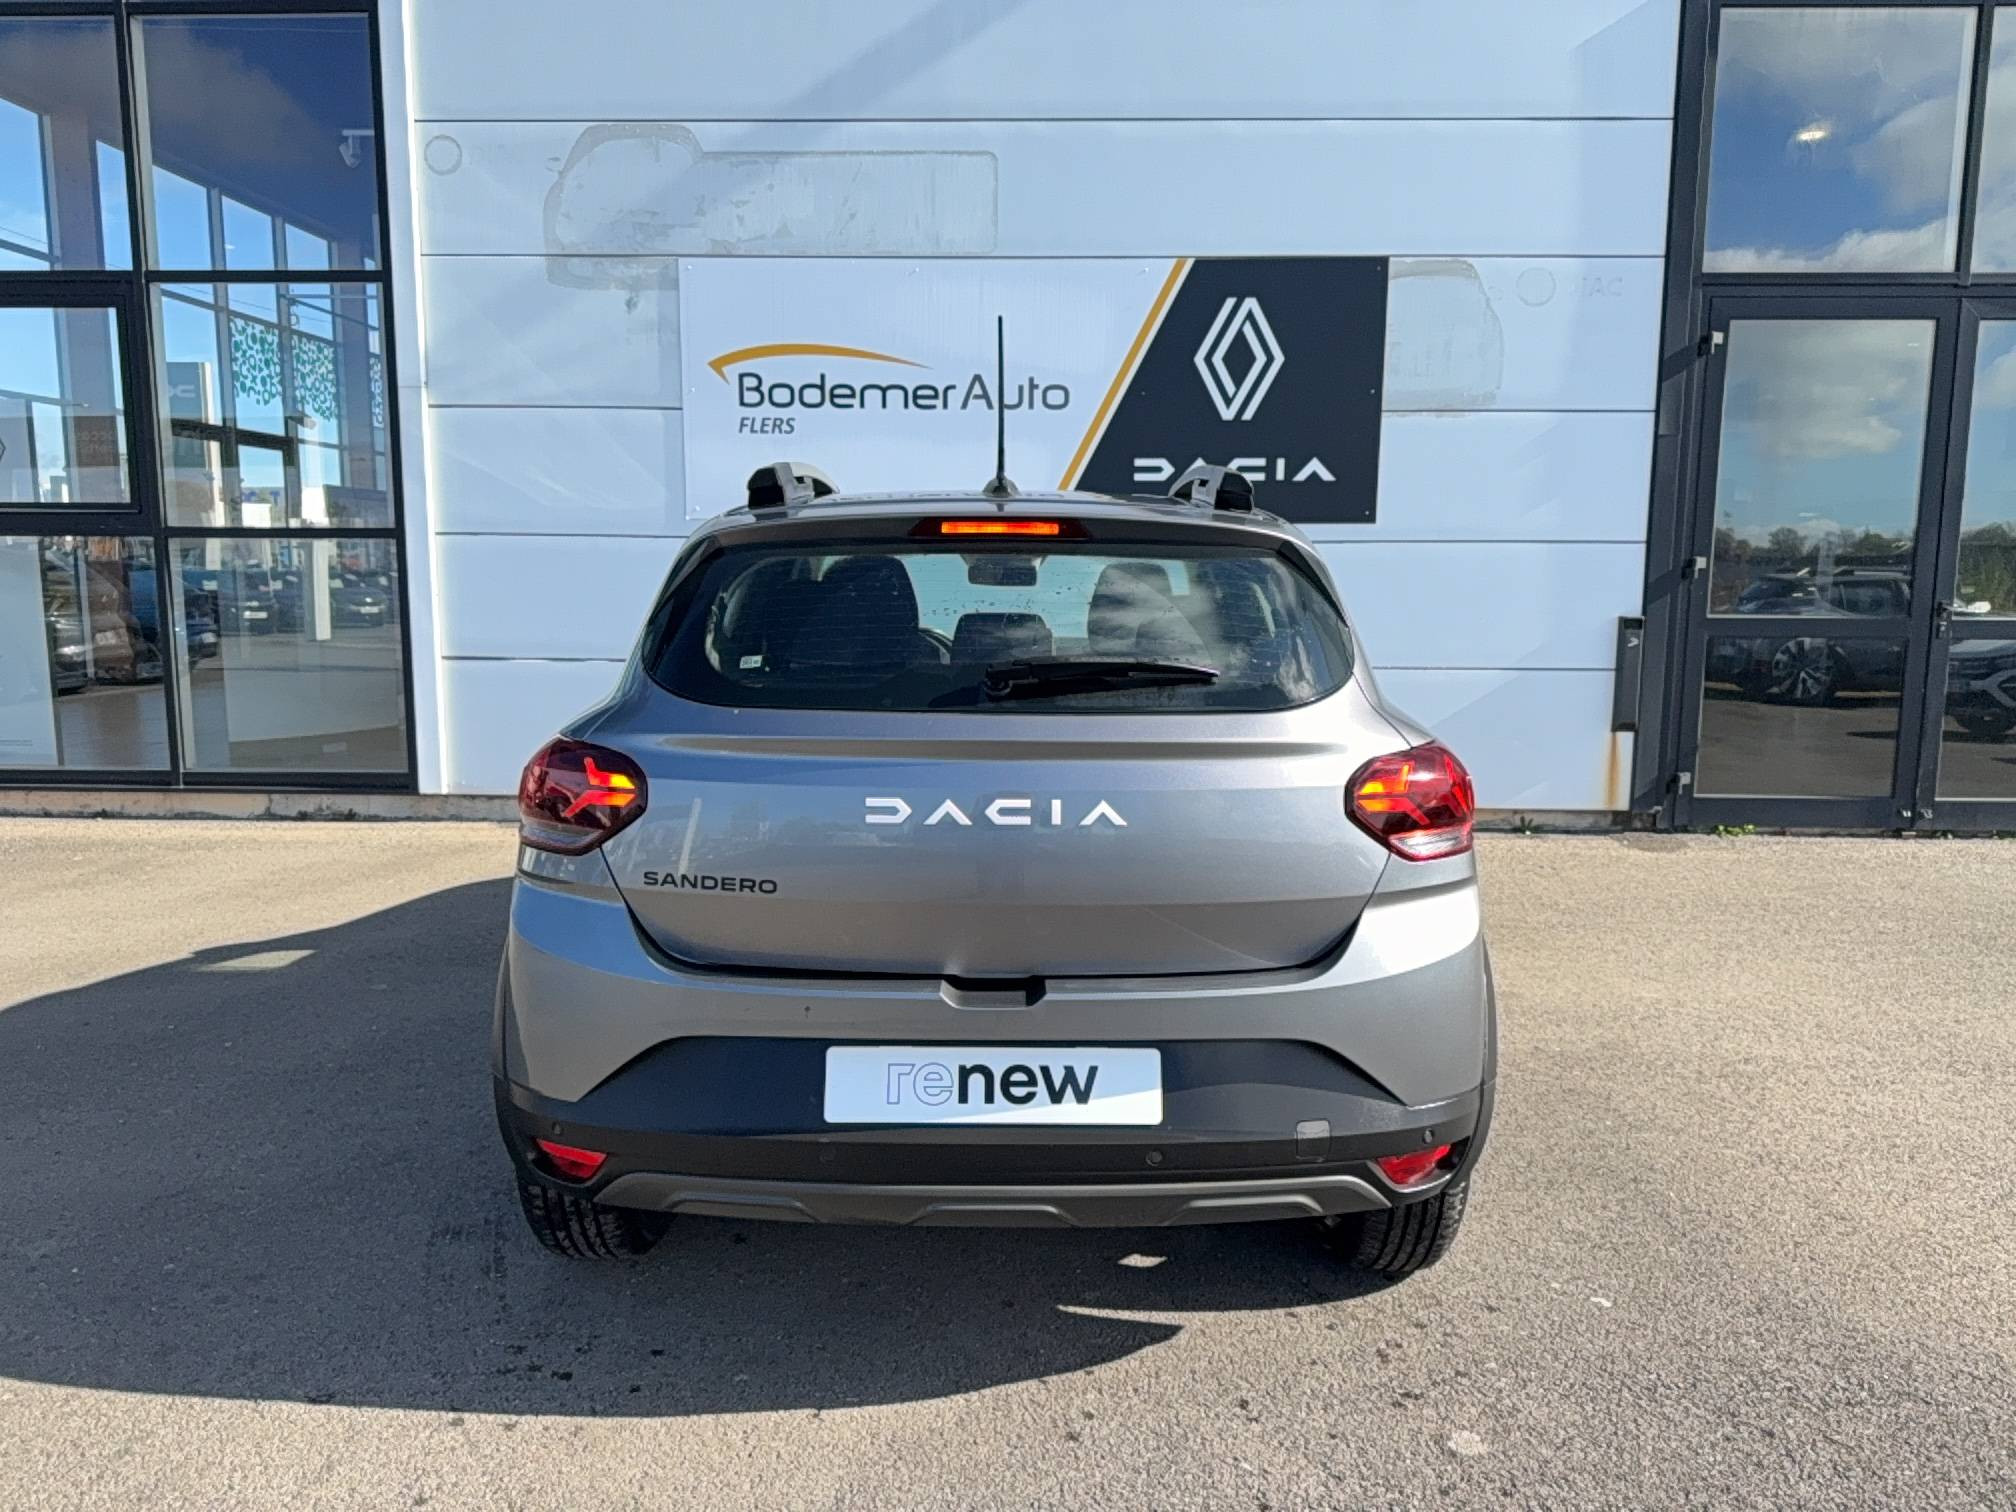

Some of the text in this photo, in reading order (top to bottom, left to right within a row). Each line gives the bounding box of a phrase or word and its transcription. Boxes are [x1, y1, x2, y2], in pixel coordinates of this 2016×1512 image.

[738, 417, 796, 434] FLERS
[1133, 457, 1336, 481] DCIA
[865, 797, 1128, 826] DACIA
[643, 871, 778, 894] SANDERO
[886, 1062, 1099, 1106] renew
